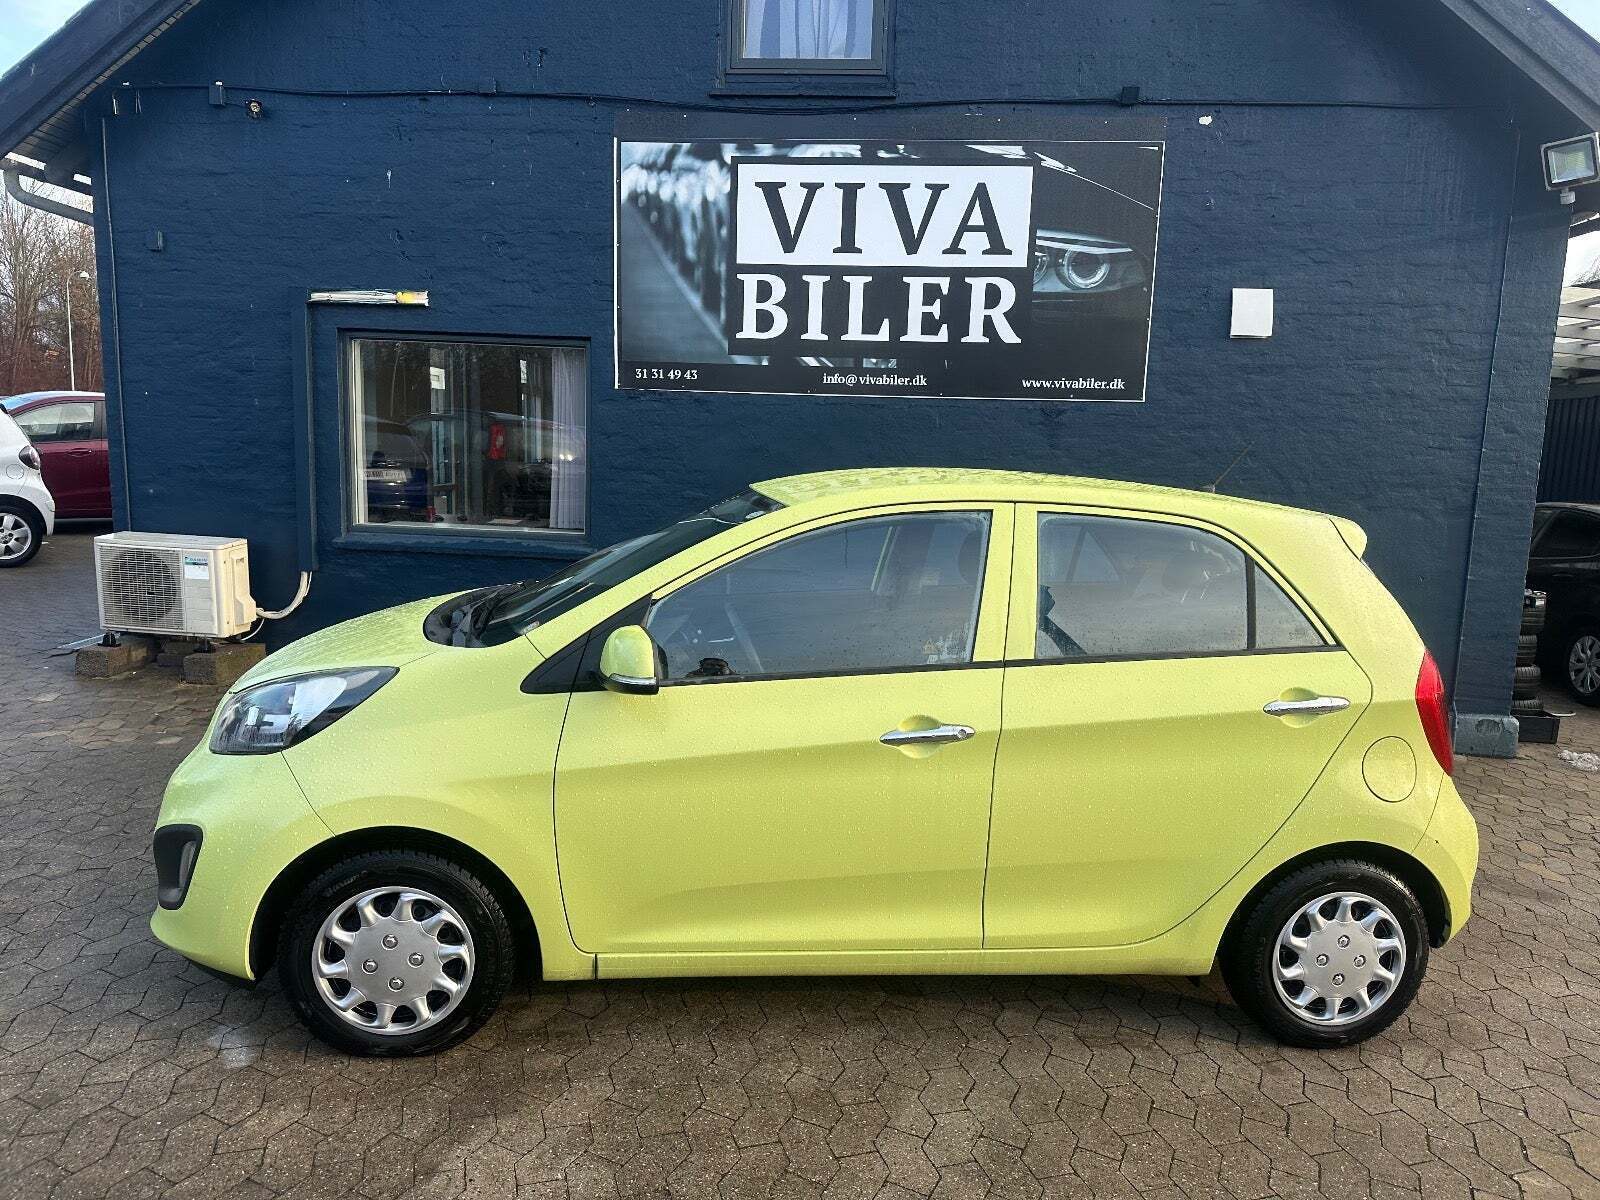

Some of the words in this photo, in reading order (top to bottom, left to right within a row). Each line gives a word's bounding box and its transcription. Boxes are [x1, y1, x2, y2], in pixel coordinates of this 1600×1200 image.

[754, 181, 1013, 255] VIVA
[735, 273, 1022, 344] BILER
[635, 368, 648, 379] 31
[651, 369, 664, 379] 31
[667, 369, 681, 380] 49
[683, 369, 698, 380] 43
[1021, 377, 1126, 390] www.vivabiler.dk
